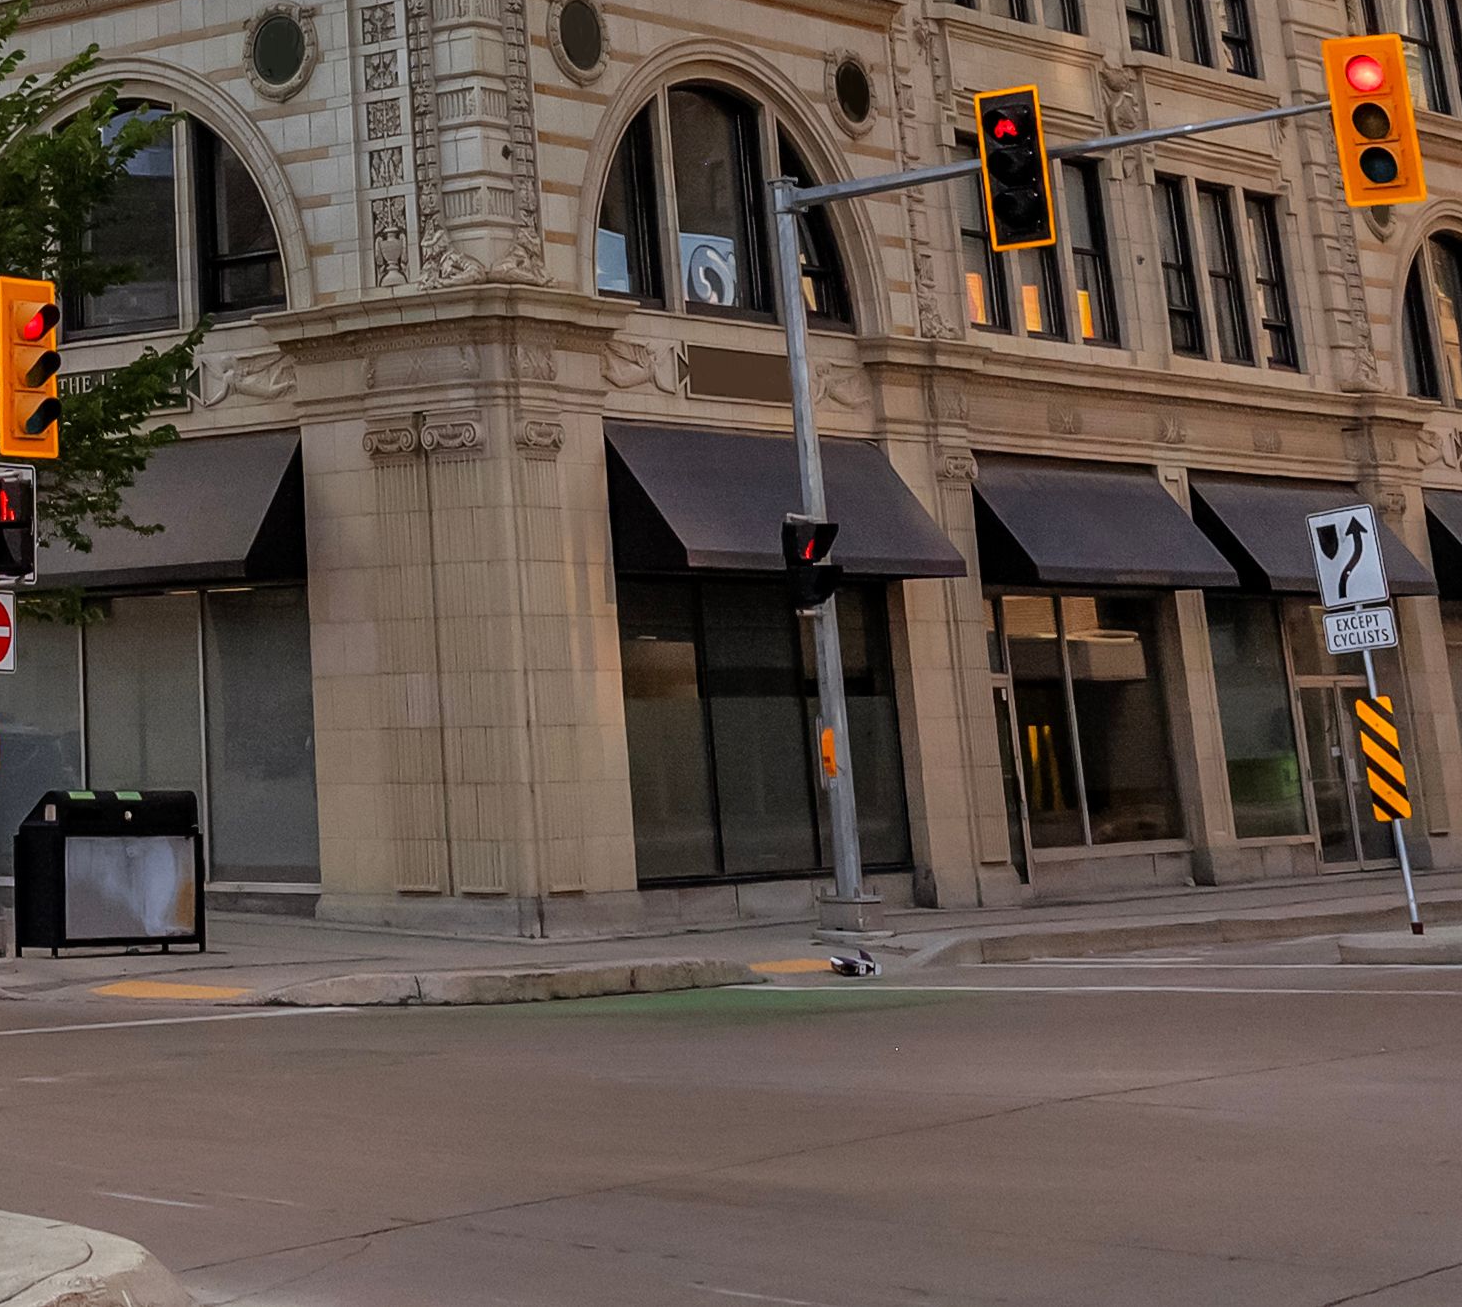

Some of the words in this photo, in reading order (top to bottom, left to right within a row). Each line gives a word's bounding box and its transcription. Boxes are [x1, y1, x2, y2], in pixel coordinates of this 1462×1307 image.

[58, 375, 93, 395] THE
[1336, 614, 1379, 632] EXCEPT
[1333, 628, 1389, 647] CYCLISTS
